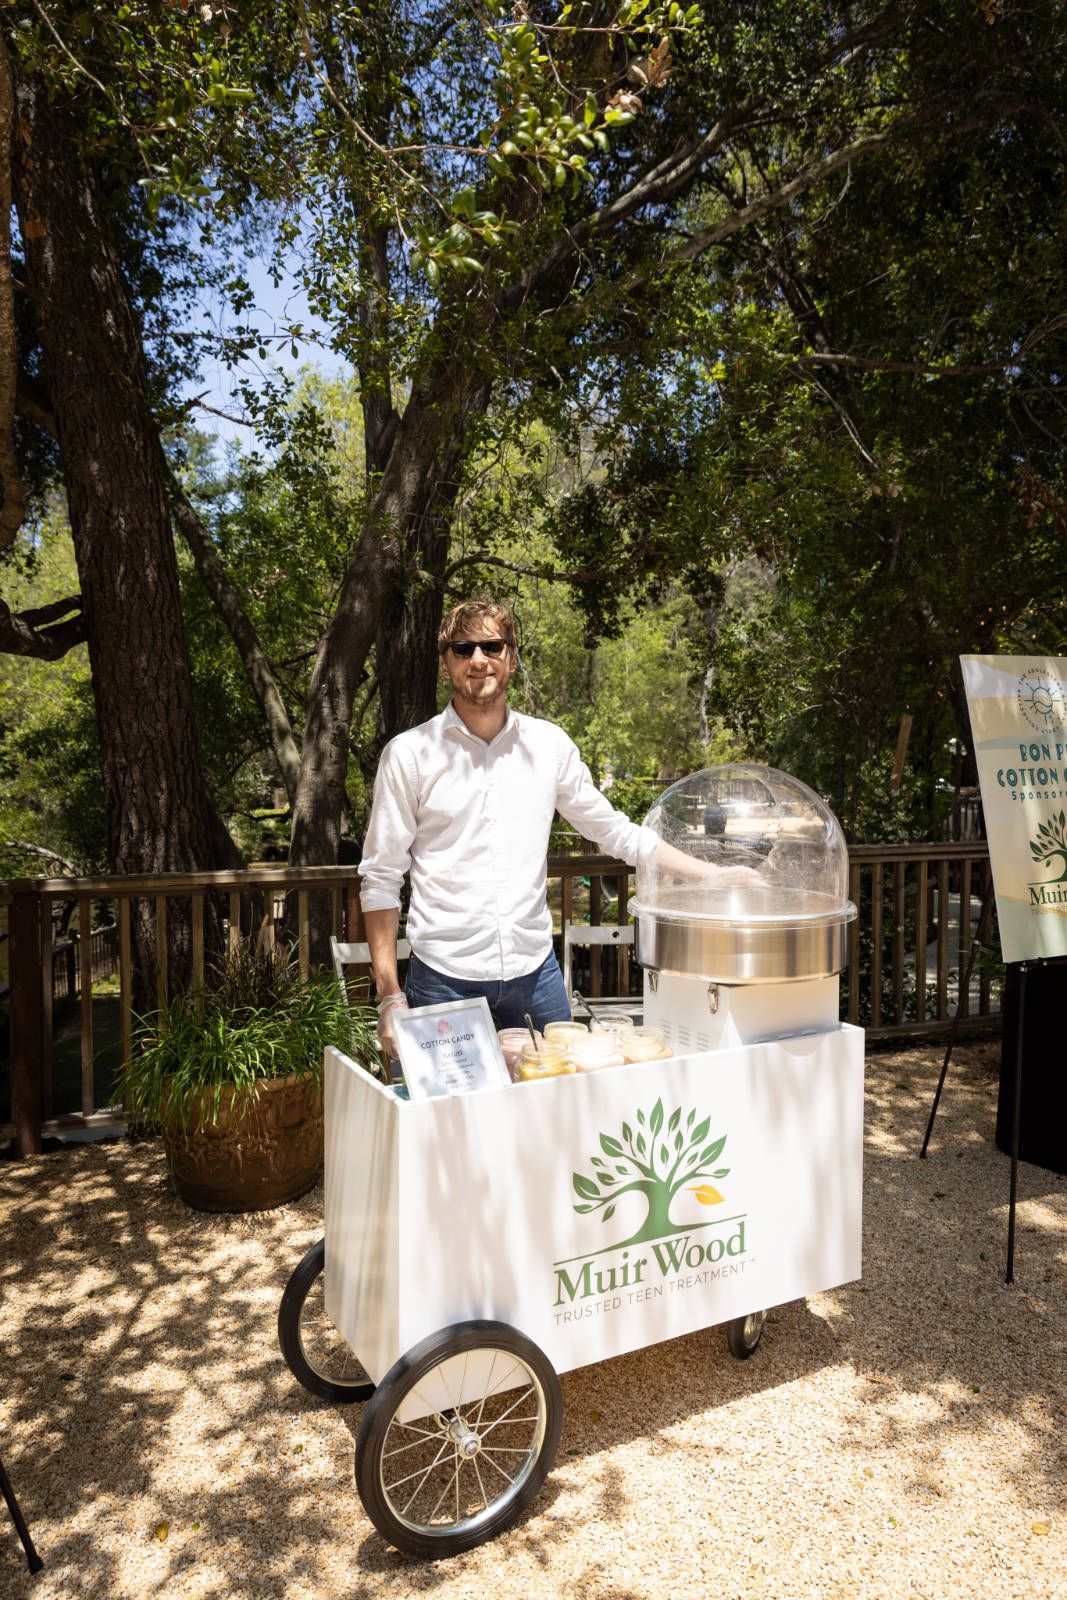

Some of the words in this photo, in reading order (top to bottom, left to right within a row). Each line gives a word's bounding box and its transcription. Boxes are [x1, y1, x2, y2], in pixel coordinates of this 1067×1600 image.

[1019, 743, 1051, 762] BON
[1055, 743, 1067, 761] P
[997, 767, 1059, 787] COTTON
[1011, 790, 1067, 803] Sponsor
[420, 1039, 450, 1049] COTTON
[451, 1033, 475, 1043] CANDY
[553, 1251, 648, 1307] Muir
[651, 1221, 748, 1277] Wood
[553, 1296, 622, 1327] TRUSTED
[626, 1285, 664, 1305] TEEN
[669, 1261, 746, 1291] TREATMENT
